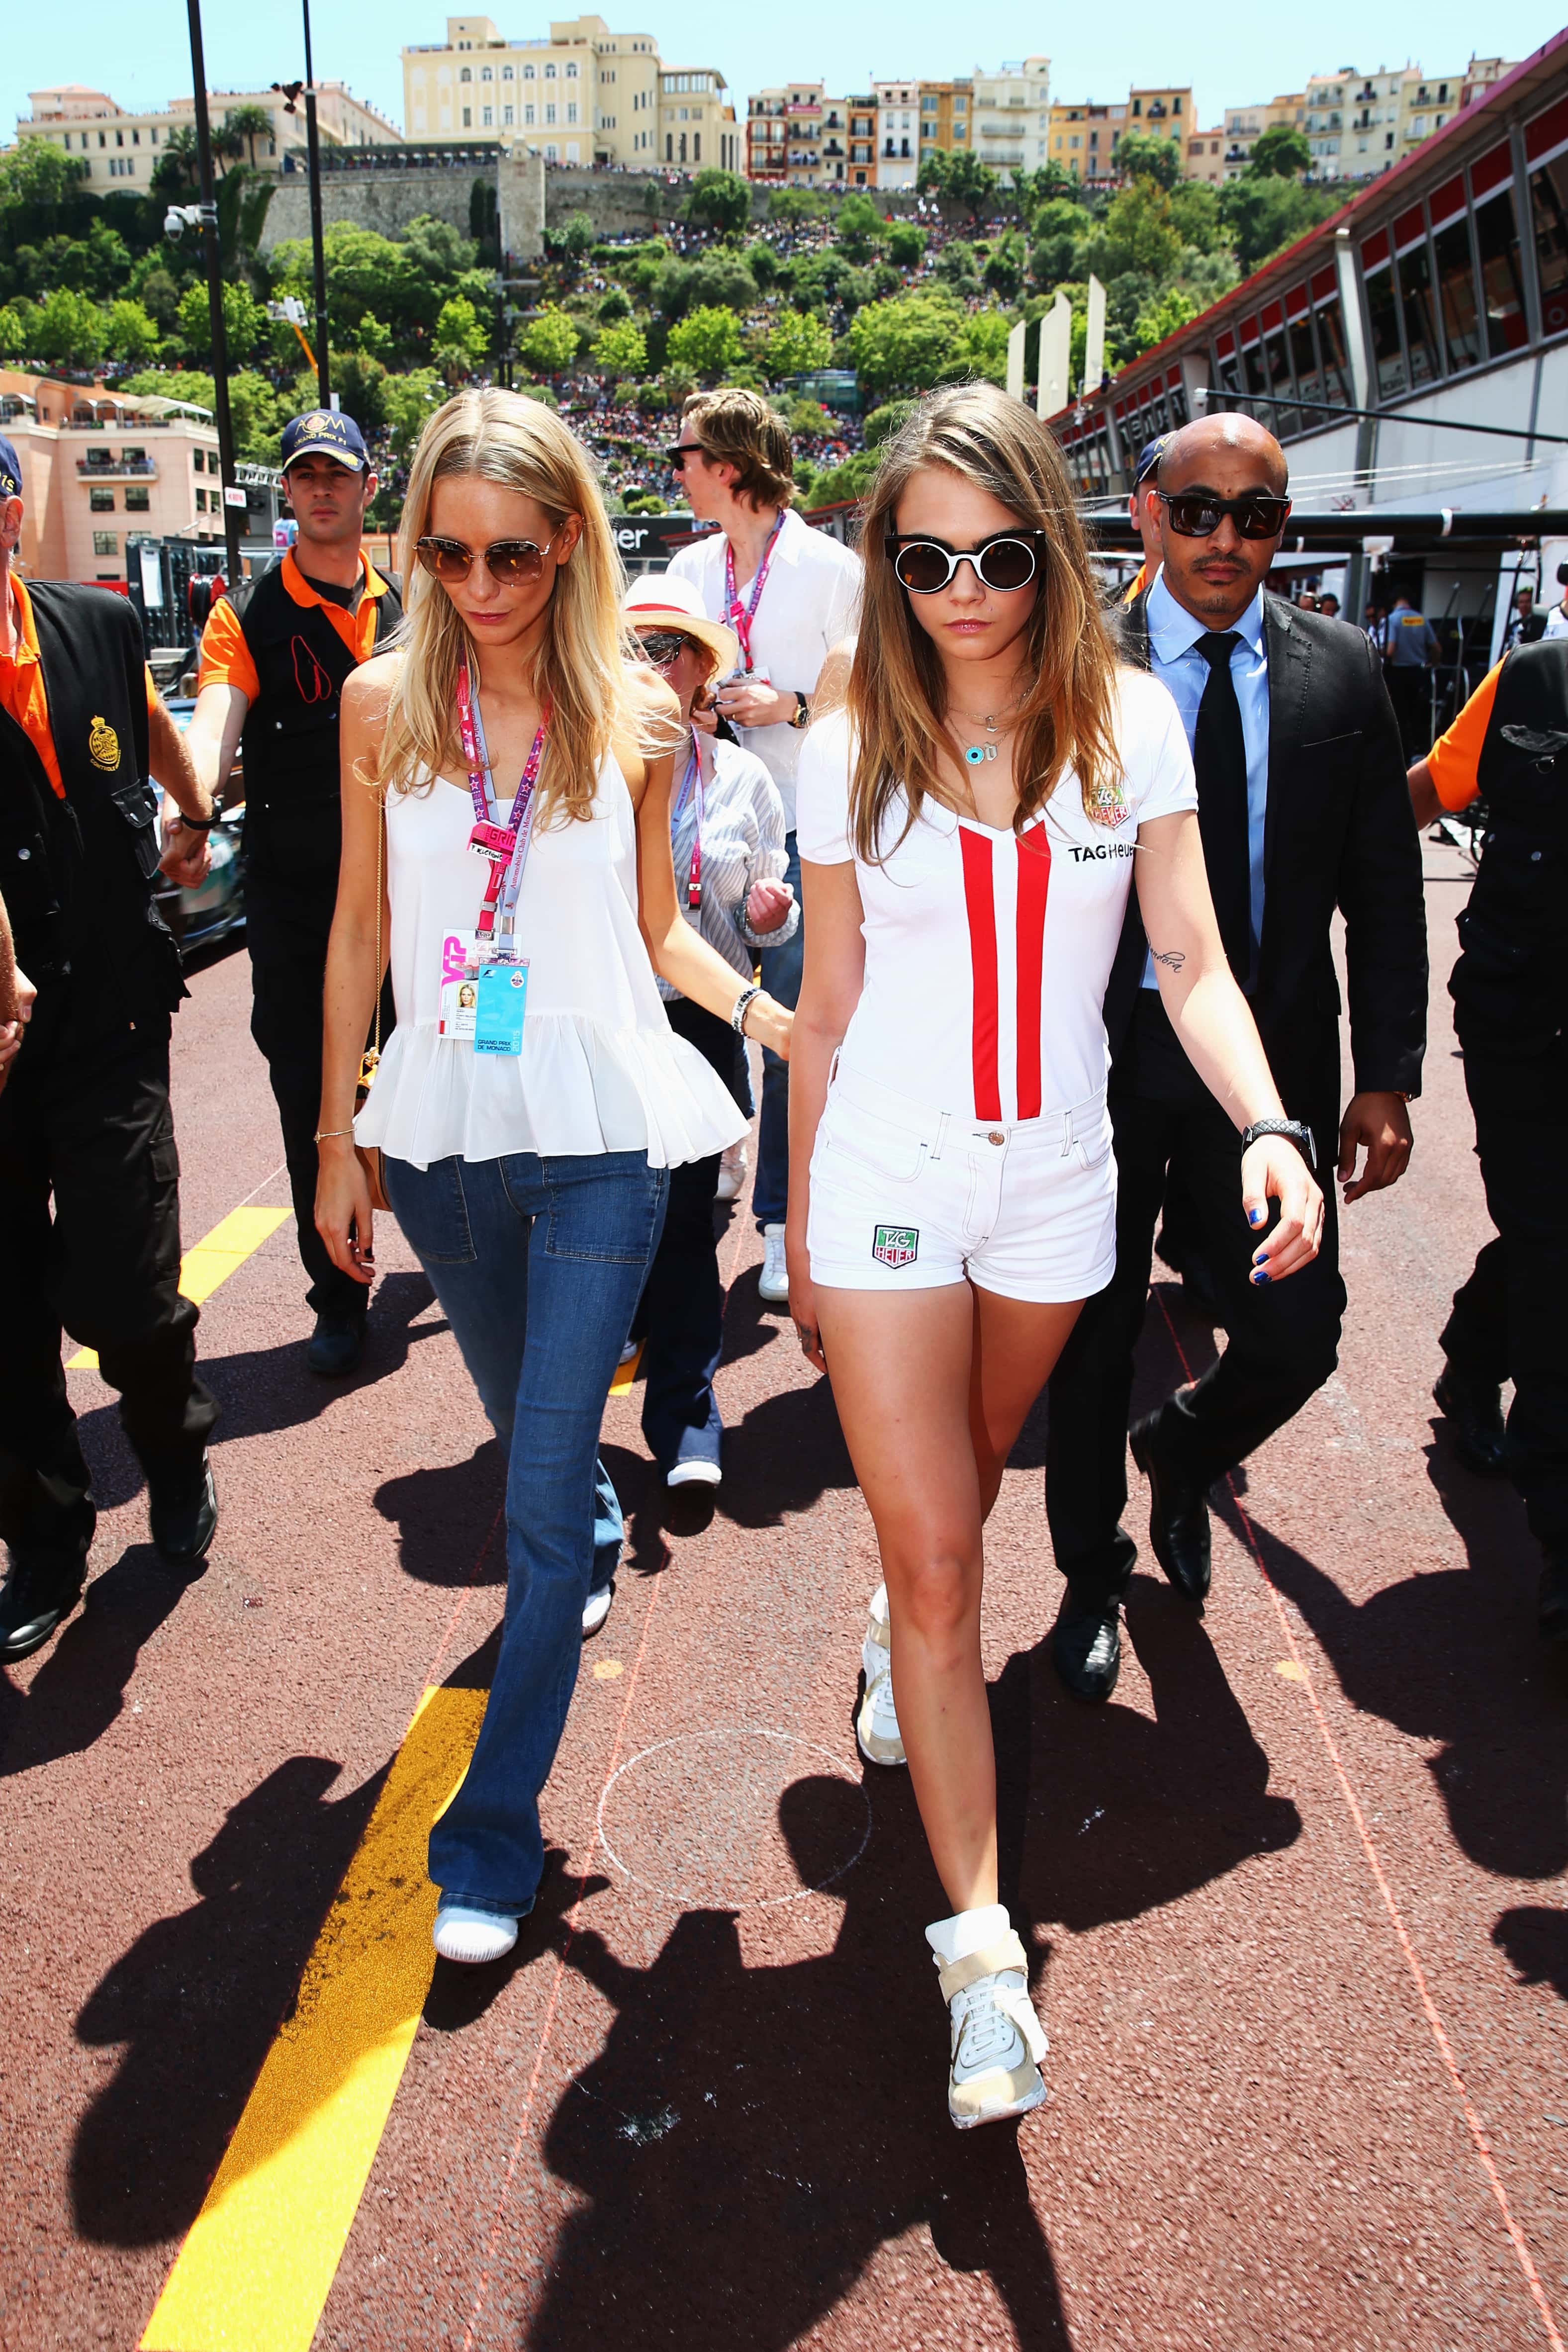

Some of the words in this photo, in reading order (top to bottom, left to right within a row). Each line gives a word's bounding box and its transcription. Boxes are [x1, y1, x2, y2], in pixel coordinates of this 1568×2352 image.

[319, 432, 337, 441] PRIX
[510, 854, 523, 889] Automobile
[518, 838, 526, 853] Club
[523, 804, 533, 828] Monaco
[1068, 845, 1107, 862] TAG
[1109, 844, 1134, 858] Heue
[442, 936, 466, 988] VIP
[512, 1030, 521, 1052] 2015
[883, 1231, 911, 1248] TAG
[877, 1247, 912, 1264] HEUER
